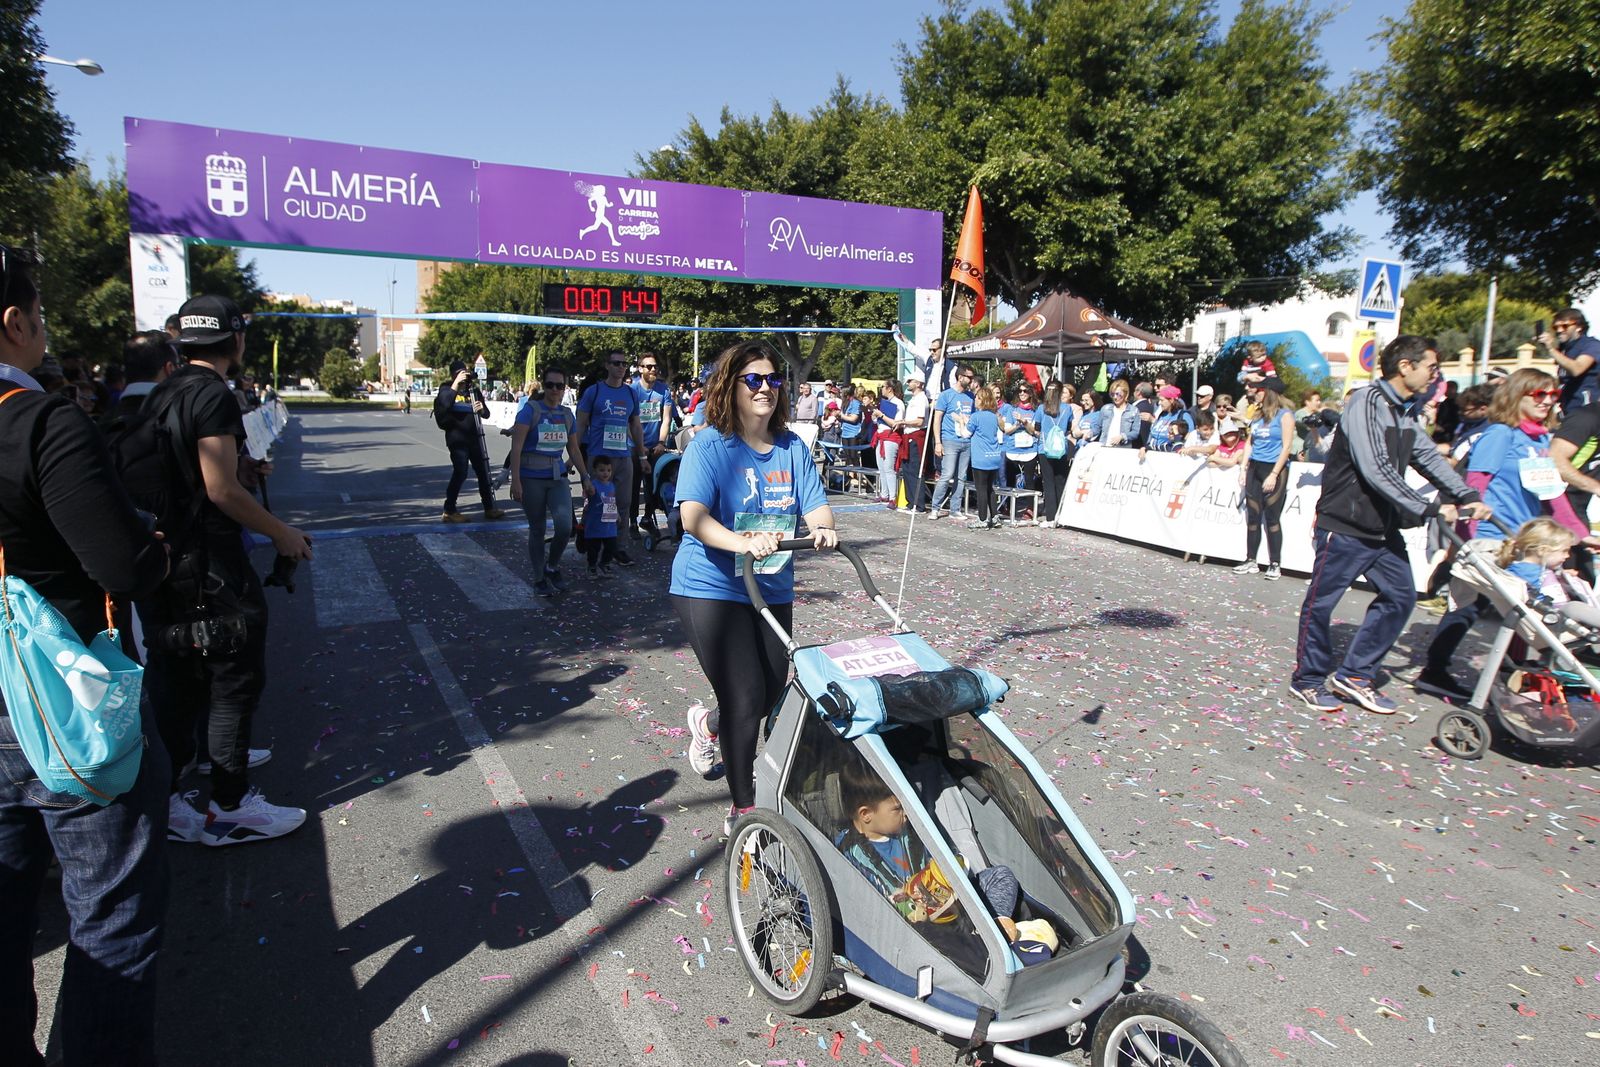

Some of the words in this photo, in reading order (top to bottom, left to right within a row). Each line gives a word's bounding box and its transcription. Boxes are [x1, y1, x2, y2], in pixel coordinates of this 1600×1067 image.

[283, 166, 441, 208] ALMERÍA
[617, 187, 657, 207] VIII
[283, 198, 367, 223] CIUDAD
[618, 208, 659, 218] CARRERA
[488, 242, 508, 256] LA
[514, 243, 596, 262] IGUALDAD
[602, 251, 619, 263] ES
[625, 252, 690, 268] NUESTRA
[694, 257, 738, 272] META.
[1104, 473, 1163, 497] ALMERÍA
[842, 651, 908, 671] ATLETA
